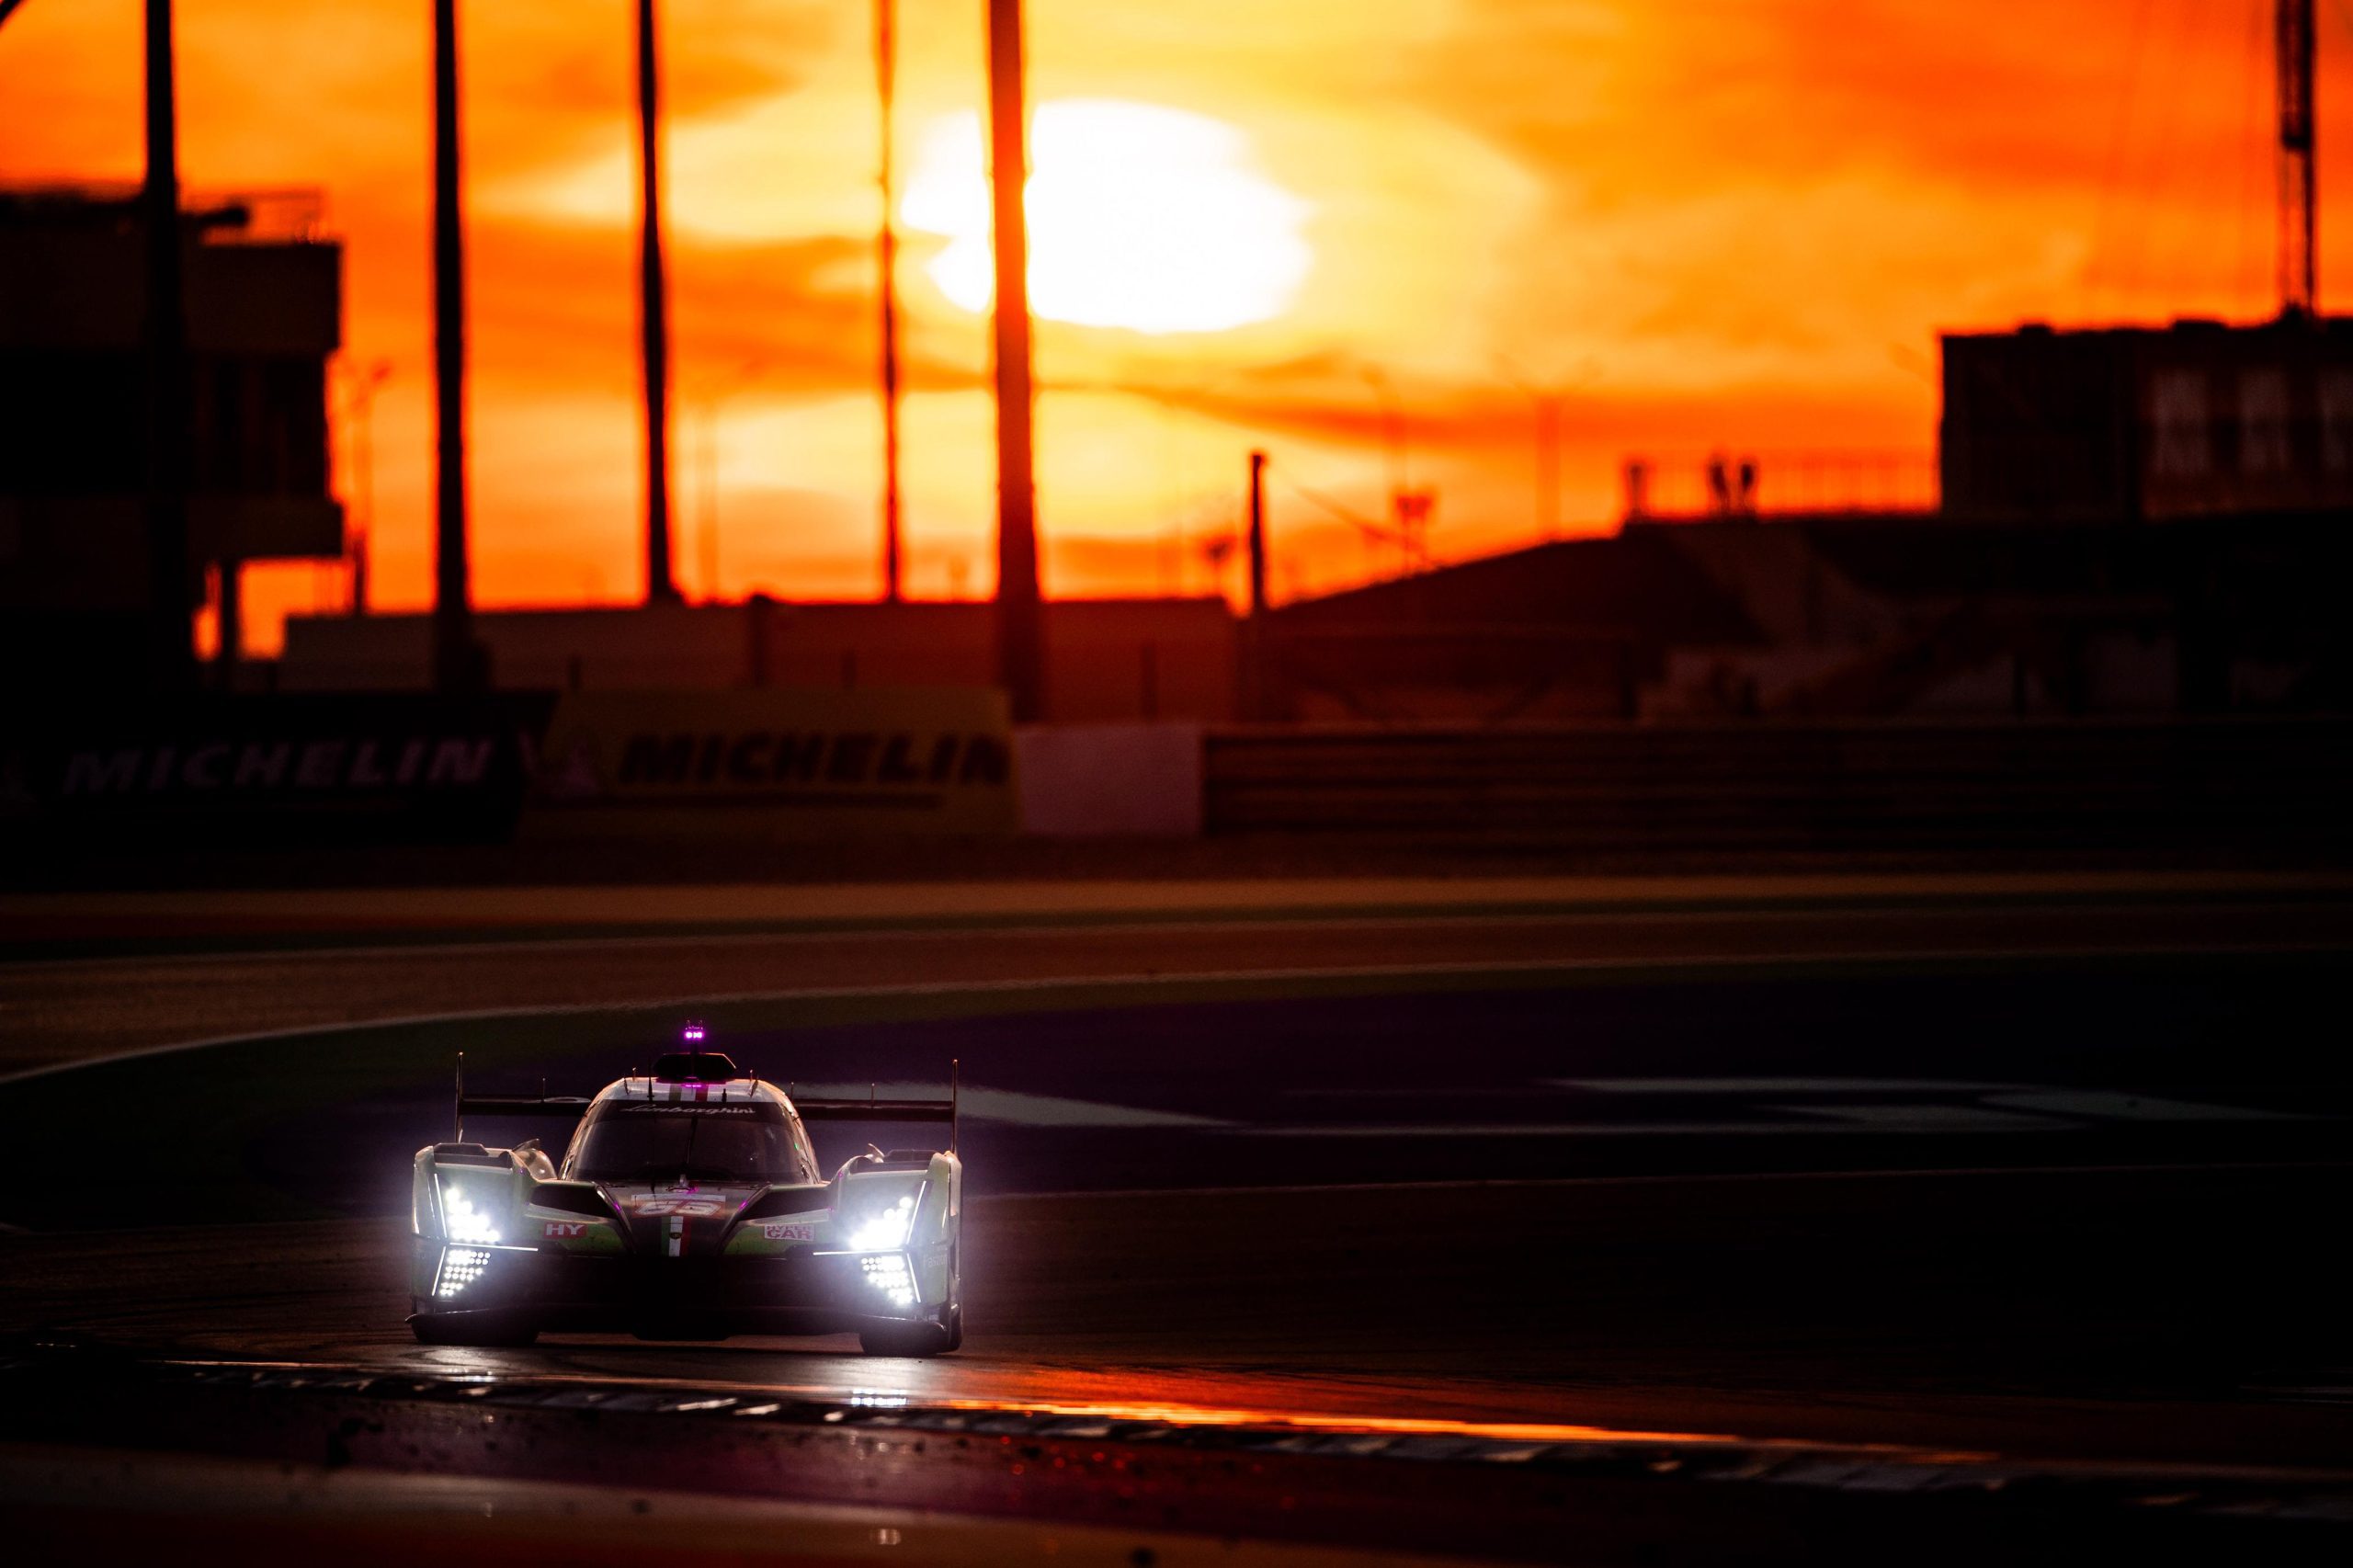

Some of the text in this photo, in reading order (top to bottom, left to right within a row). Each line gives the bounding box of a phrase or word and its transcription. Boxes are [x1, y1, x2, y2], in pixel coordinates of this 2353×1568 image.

[620, 733, 1010, 784] MICHELIN
[62, 737, 493, 795] MICHELIN
[620, 1103, 756, 1115] Lamborghini
[546, 1223, 585, 1236] HY
[767, 1230, 811, 1240] CAR
